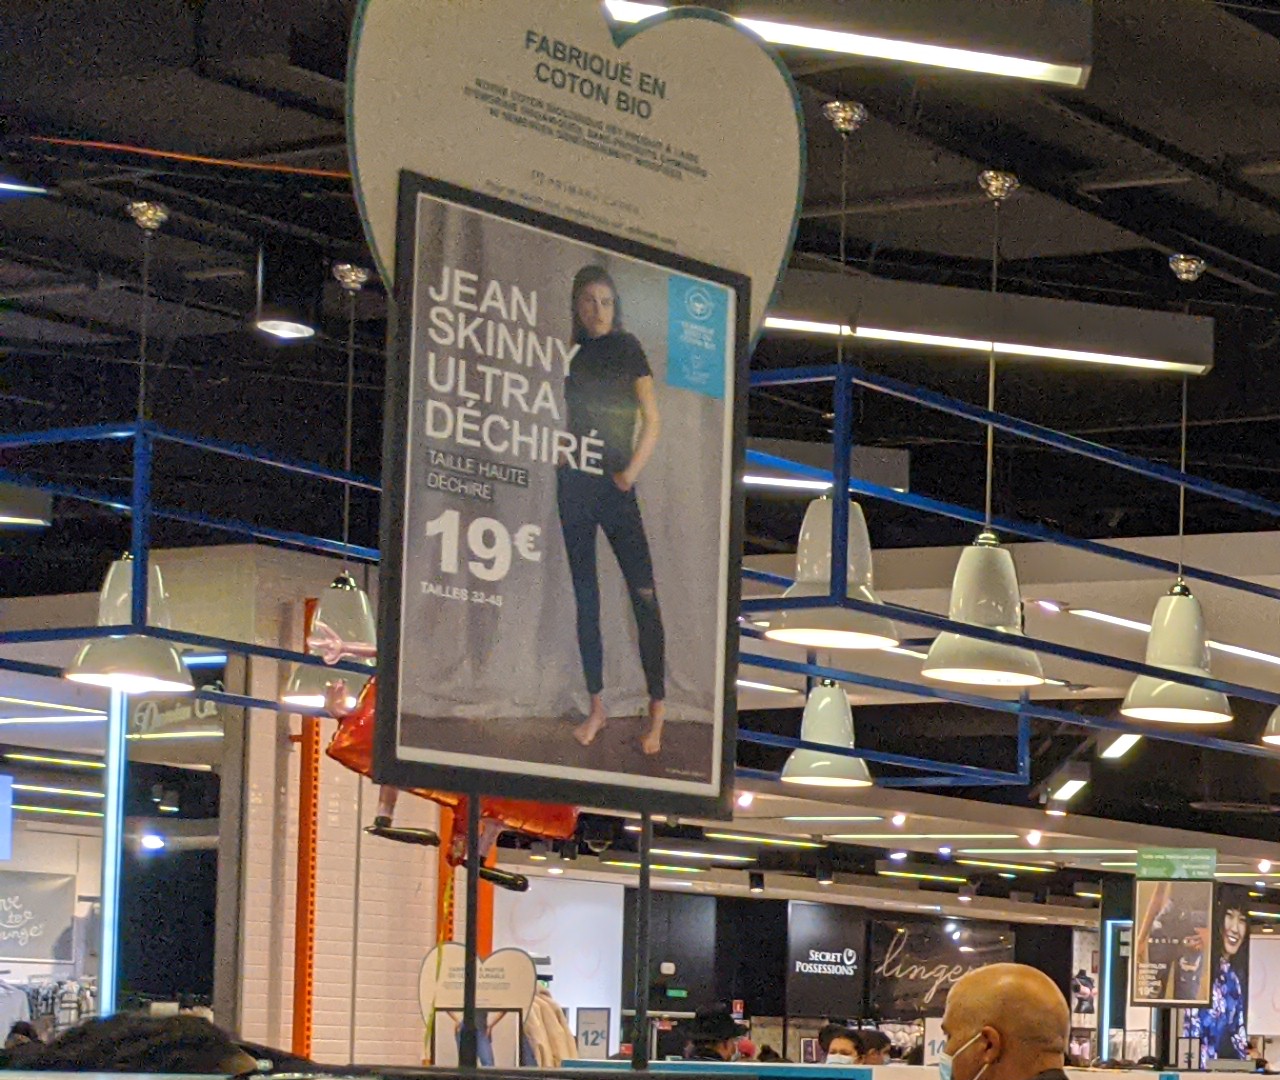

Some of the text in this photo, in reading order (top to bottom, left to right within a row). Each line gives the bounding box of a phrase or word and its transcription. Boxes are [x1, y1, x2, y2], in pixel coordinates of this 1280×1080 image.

[525, 30, 666, 99] FABRIQUÉ EN
[536, 62, 610, 105] COTON
[617, 90, 651, 119] BIO
[429, 267, 538, 326] JEAN
[428, 307, 581, 377] SKINNY
[428, 352, 561, 420] ULTRA
[426, 399, 605, 475] DÉCHIRÉ
[426, 509, 541, 582] 19€
[795, 960, 858, 976] POSSESSIONS
[809, 949, 843, 964] SECRET
[874, 930, 976, 1004] linge
